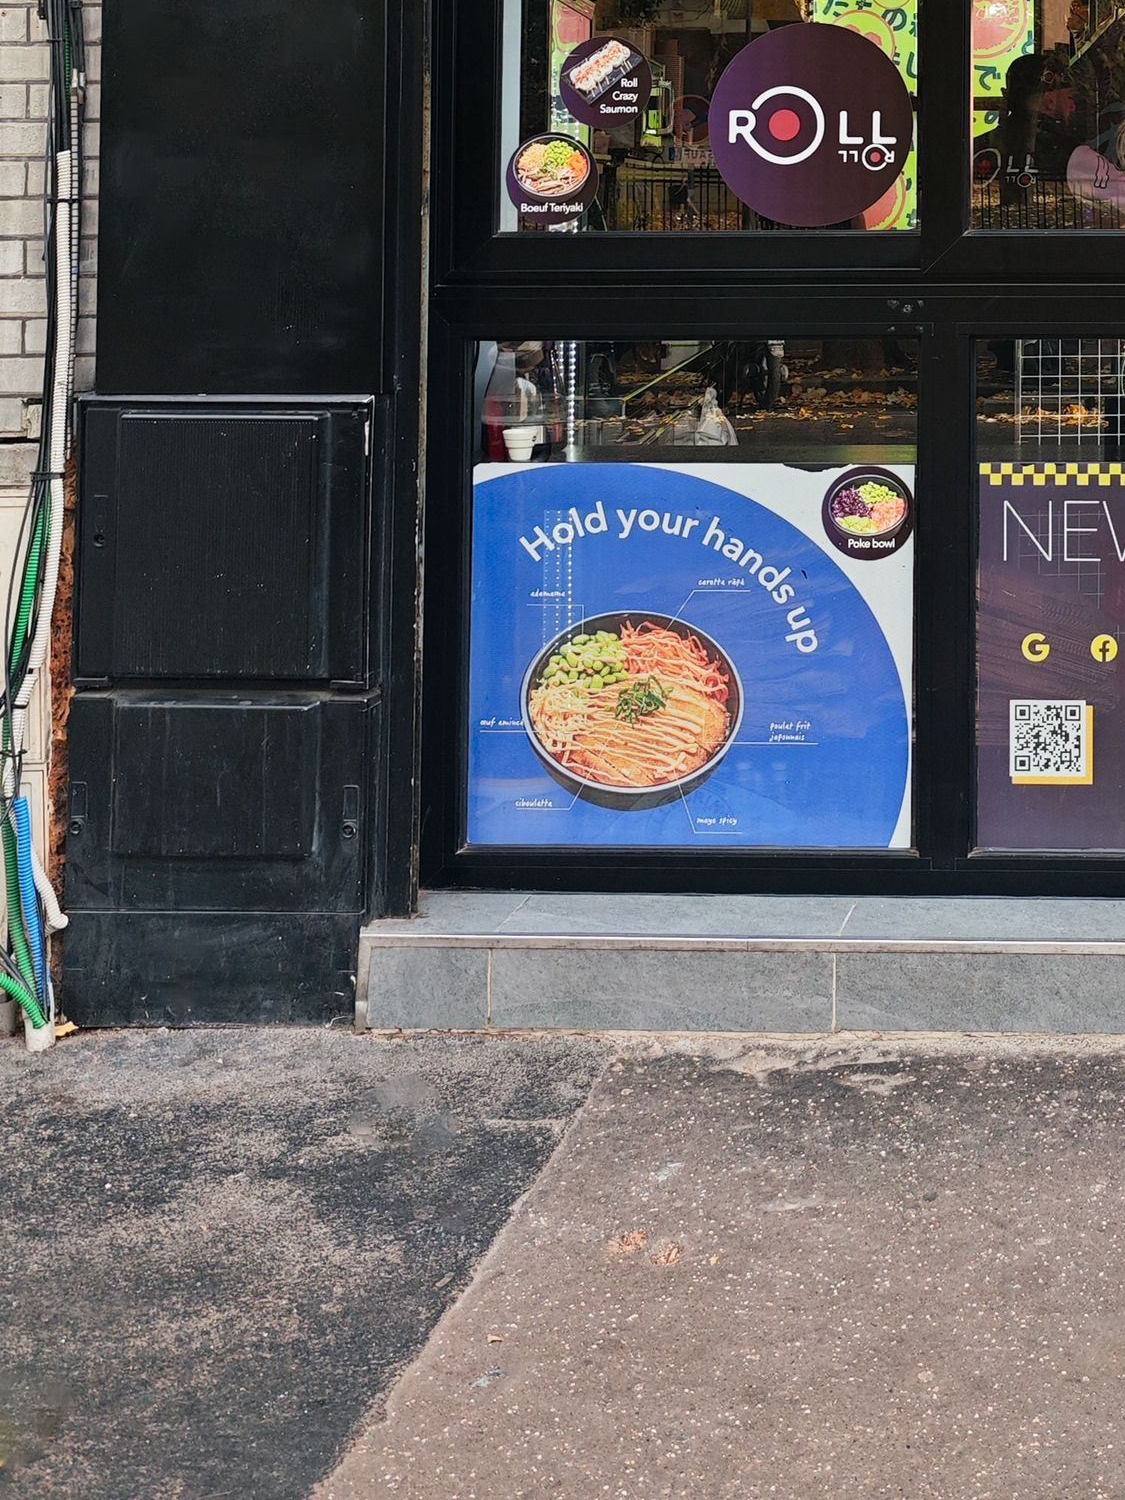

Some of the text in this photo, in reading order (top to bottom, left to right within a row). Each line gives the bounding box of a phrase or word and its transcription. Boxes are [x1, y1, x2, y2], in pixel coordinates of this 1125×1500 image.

[620, 77, 639, 88] Roll
[612, 90, 639, 103] Crazy
[599, 103, 639, 114] Saumon
[728, 85, 897, 165] ROLL
[520, 202, 584, 215] Boeuf Teriyaki
[847, 537, 896, 550] Poke bowl
[519, 501, 820, 654] Hold your hands up
[769, 720, 812, 732] poulet frit
[514, 797, 553, 808] ciboulette
[718, 814, 738, 827] spicy
